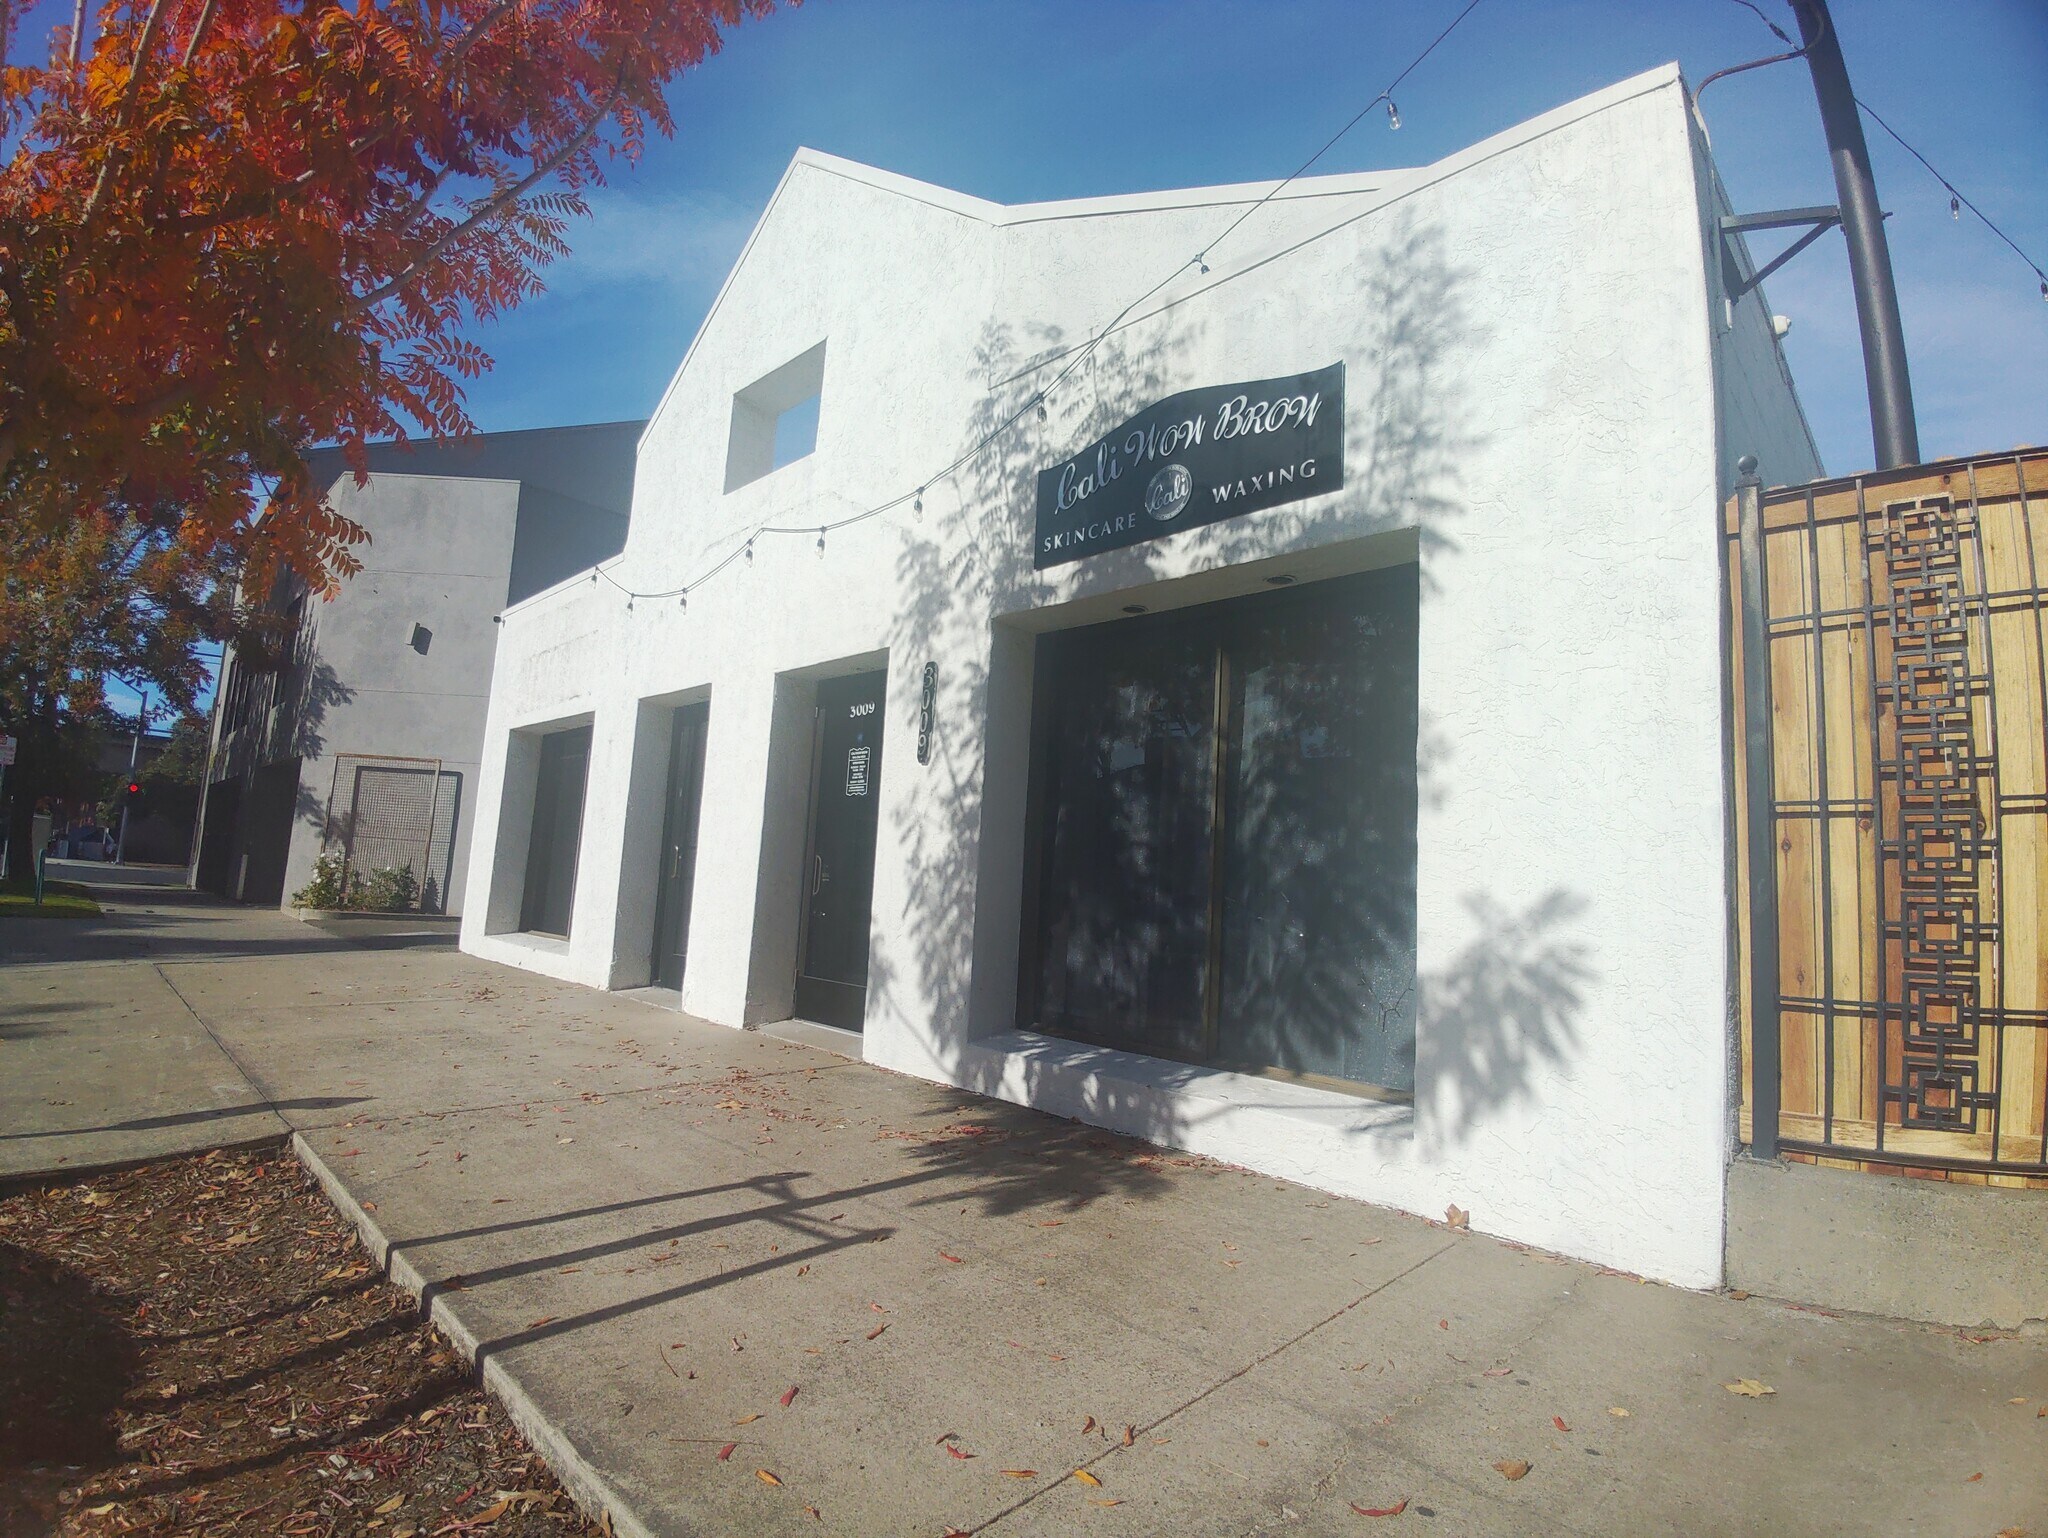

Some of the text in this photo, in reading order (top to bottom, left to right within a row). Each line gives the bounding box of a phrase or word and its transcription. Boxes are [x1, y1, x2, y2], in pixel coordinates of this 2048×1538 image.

[1055, 441, 1123, 515] Cali
[1213, 392, 1323, 441] BROW
[1145, 473, 1190, 515] Cali
[1212, 458, 1317, 504] WAXING
[1043, 512, 1137, 553] SKINCARE
[850, 701, 875, 718] 3009
[918, 666, 934, 755] 3009
